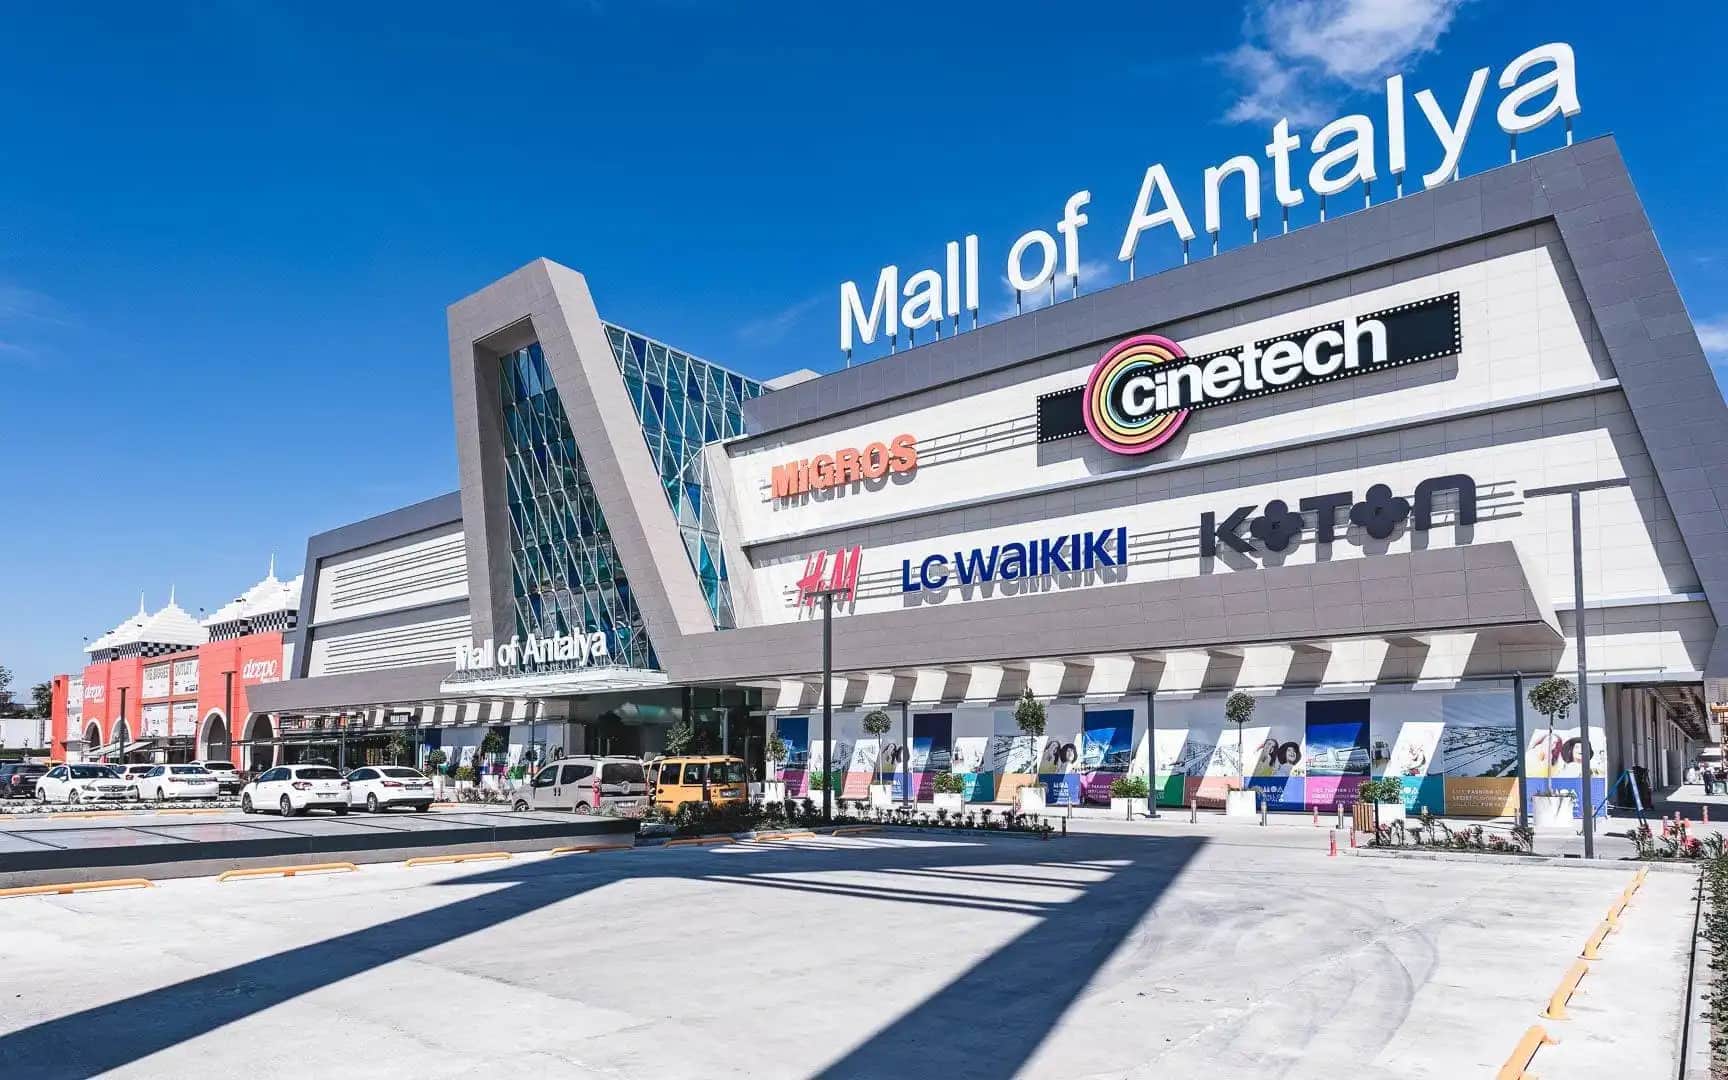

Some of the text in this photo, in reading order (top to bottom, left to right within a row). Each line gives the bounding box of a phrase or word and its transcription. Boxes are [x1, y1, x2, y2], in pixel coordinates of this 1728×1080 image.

[840, 41, 1582, 351] Mall of Antalya
[1121, 316, 1388, 417] cinetech
[902, 553, 948, 592] LC
[456, 627, 607, 670] Mall of Antalya
